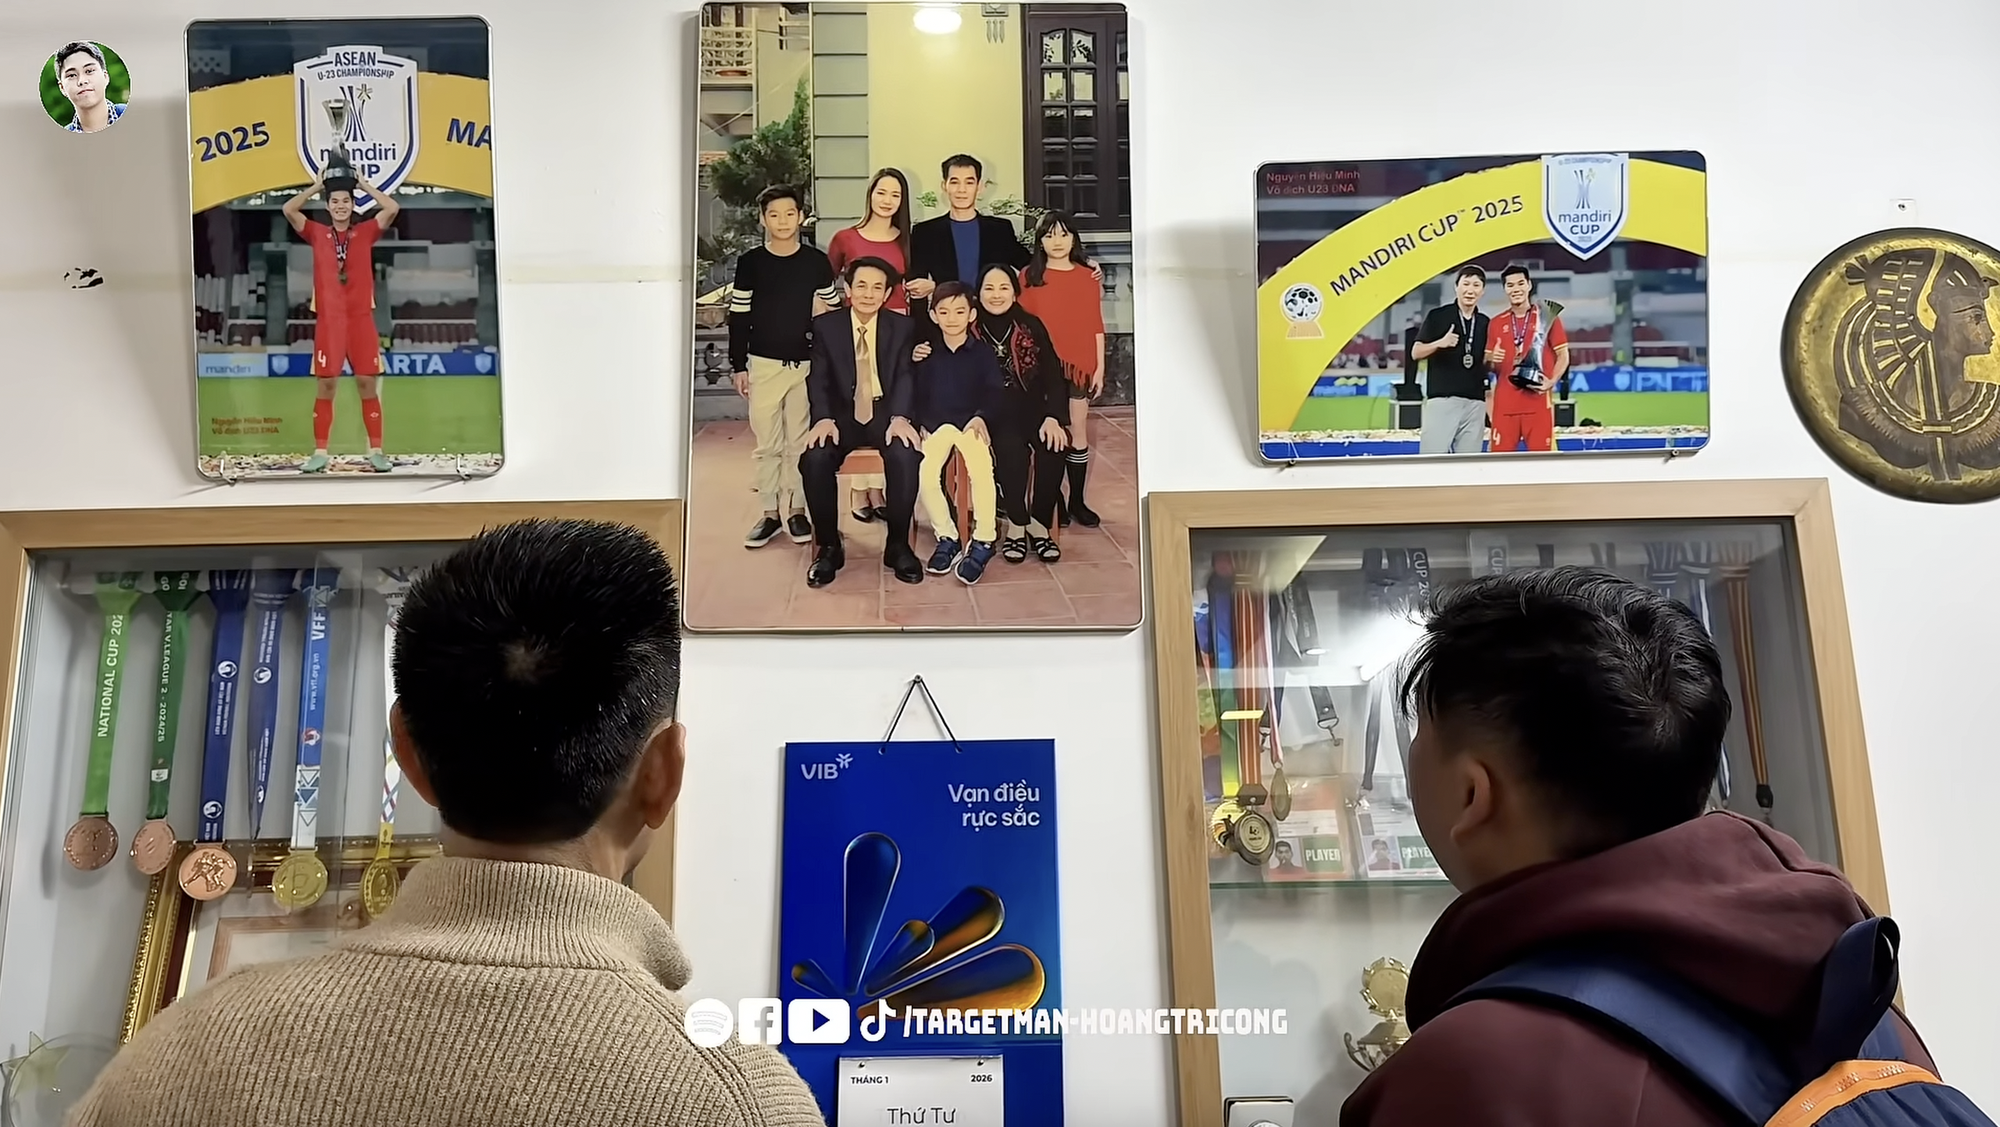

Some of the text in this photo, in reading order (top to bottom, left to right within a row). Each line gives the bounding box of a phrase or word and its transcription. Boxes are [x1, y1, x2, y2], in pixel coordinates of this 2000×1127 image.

[334, 51, 376, 66] ASEAN
[318, 68, 395, 81] U-23 CHAMPIONSHIP
[195, 121, 270, 163] 2025
[320, 142, 397, 162] mndiri
[1335, 170, 1360, 180] Minh
[1307, 184, 1329, 194] U23
[1558, 210, 1612, 224] mandiri
[1570, 224, 1600, 235] CUP
[1329, 233, 1417, 297] MANDIRI
[1471, 195, 1524, 223] 2025
[318, 350, 326, 368] 4
[1413, 551, 1428, 578] CUP
[310, 611, 326, 641] VFF
[106, 638, 119, 667] CUP
[97, 670, 116, 738] NATIONAL
[801, 763, 839, 780] VIB
[948, 779, 1040, 808] Vạn điều
[962, 804, 1040, 832] rực sắc
[1306, 848, 1341, 862] PLAYER
[850, 1074, 993, 1085] THÁNG 1 2026
[886, 1106, 957, 1125] Thứ Tư
